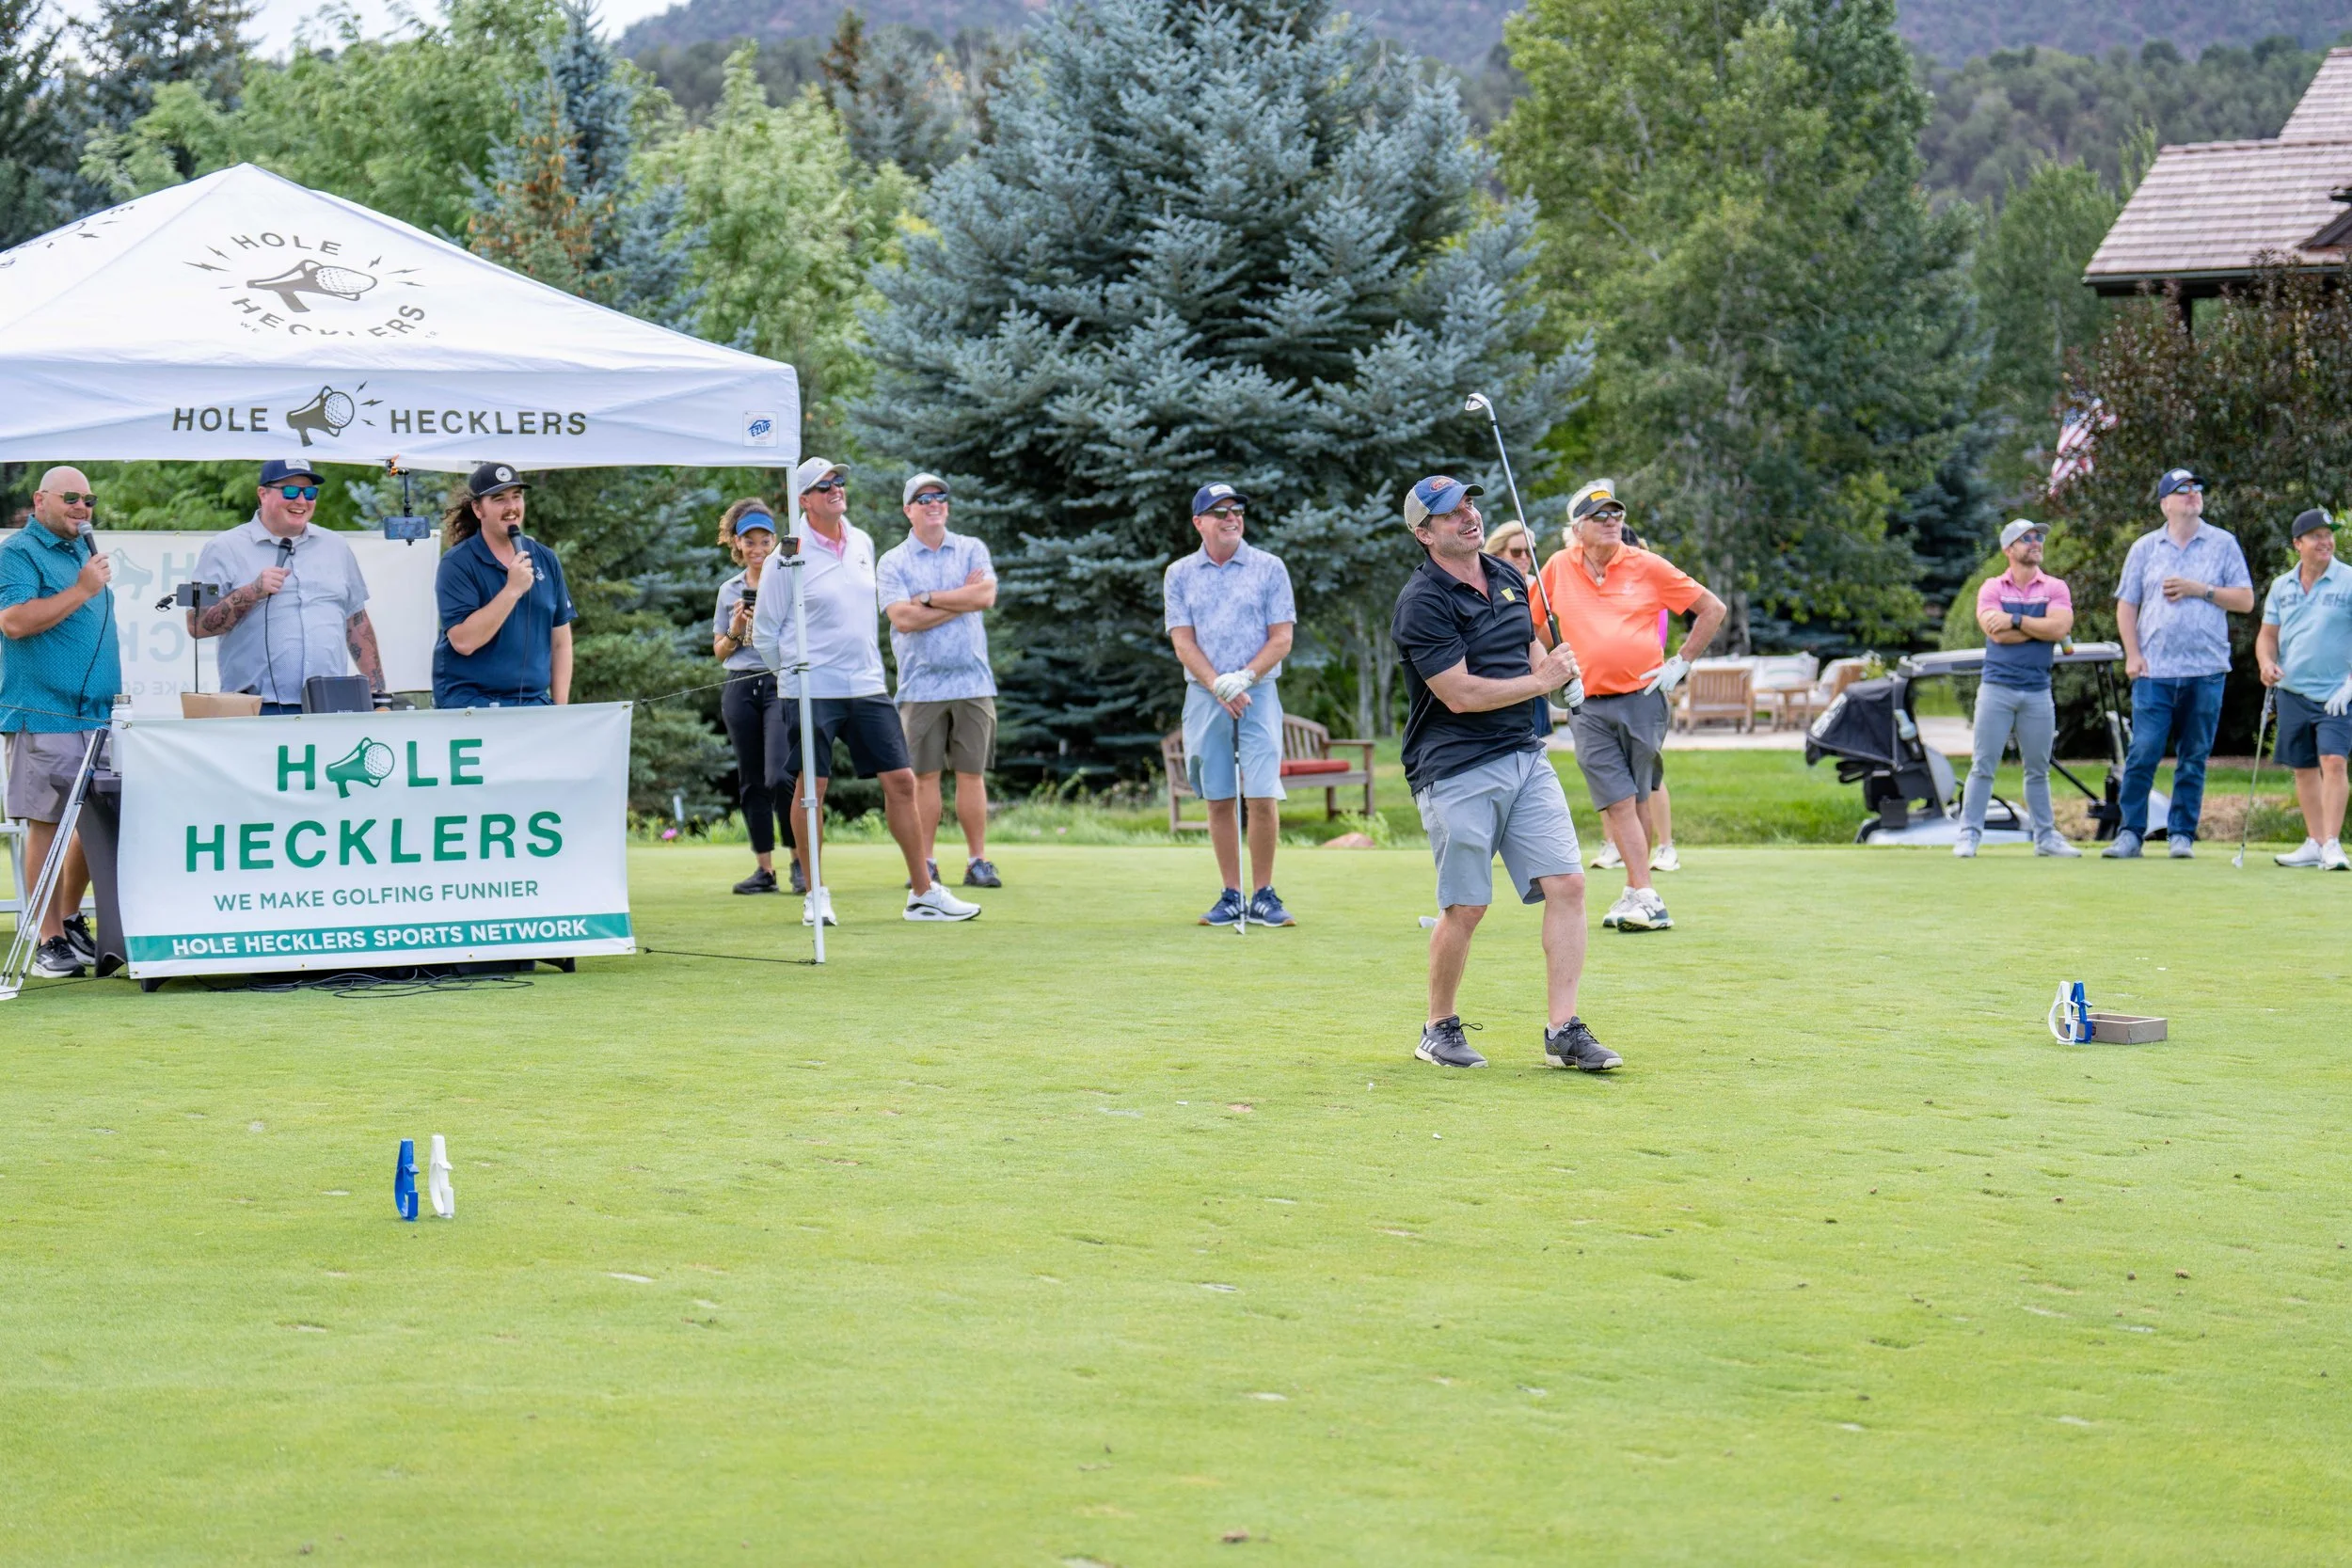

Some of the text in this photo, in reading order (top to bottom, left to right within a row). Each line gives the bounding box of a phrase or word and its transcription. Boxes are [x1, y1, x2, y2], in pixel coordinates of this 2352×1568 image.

[230, 231, 342, 256] HOLE
[172, 407, 586, 436] HOLE HECKLERS
[186, 811, 563, 873] HECKLERS
[214, 879, 538, 911] WE MAKE GOLFING FUNNIER
[172, 918, 589, 956] HOLE HECKLERS SPORTS NETWORK
